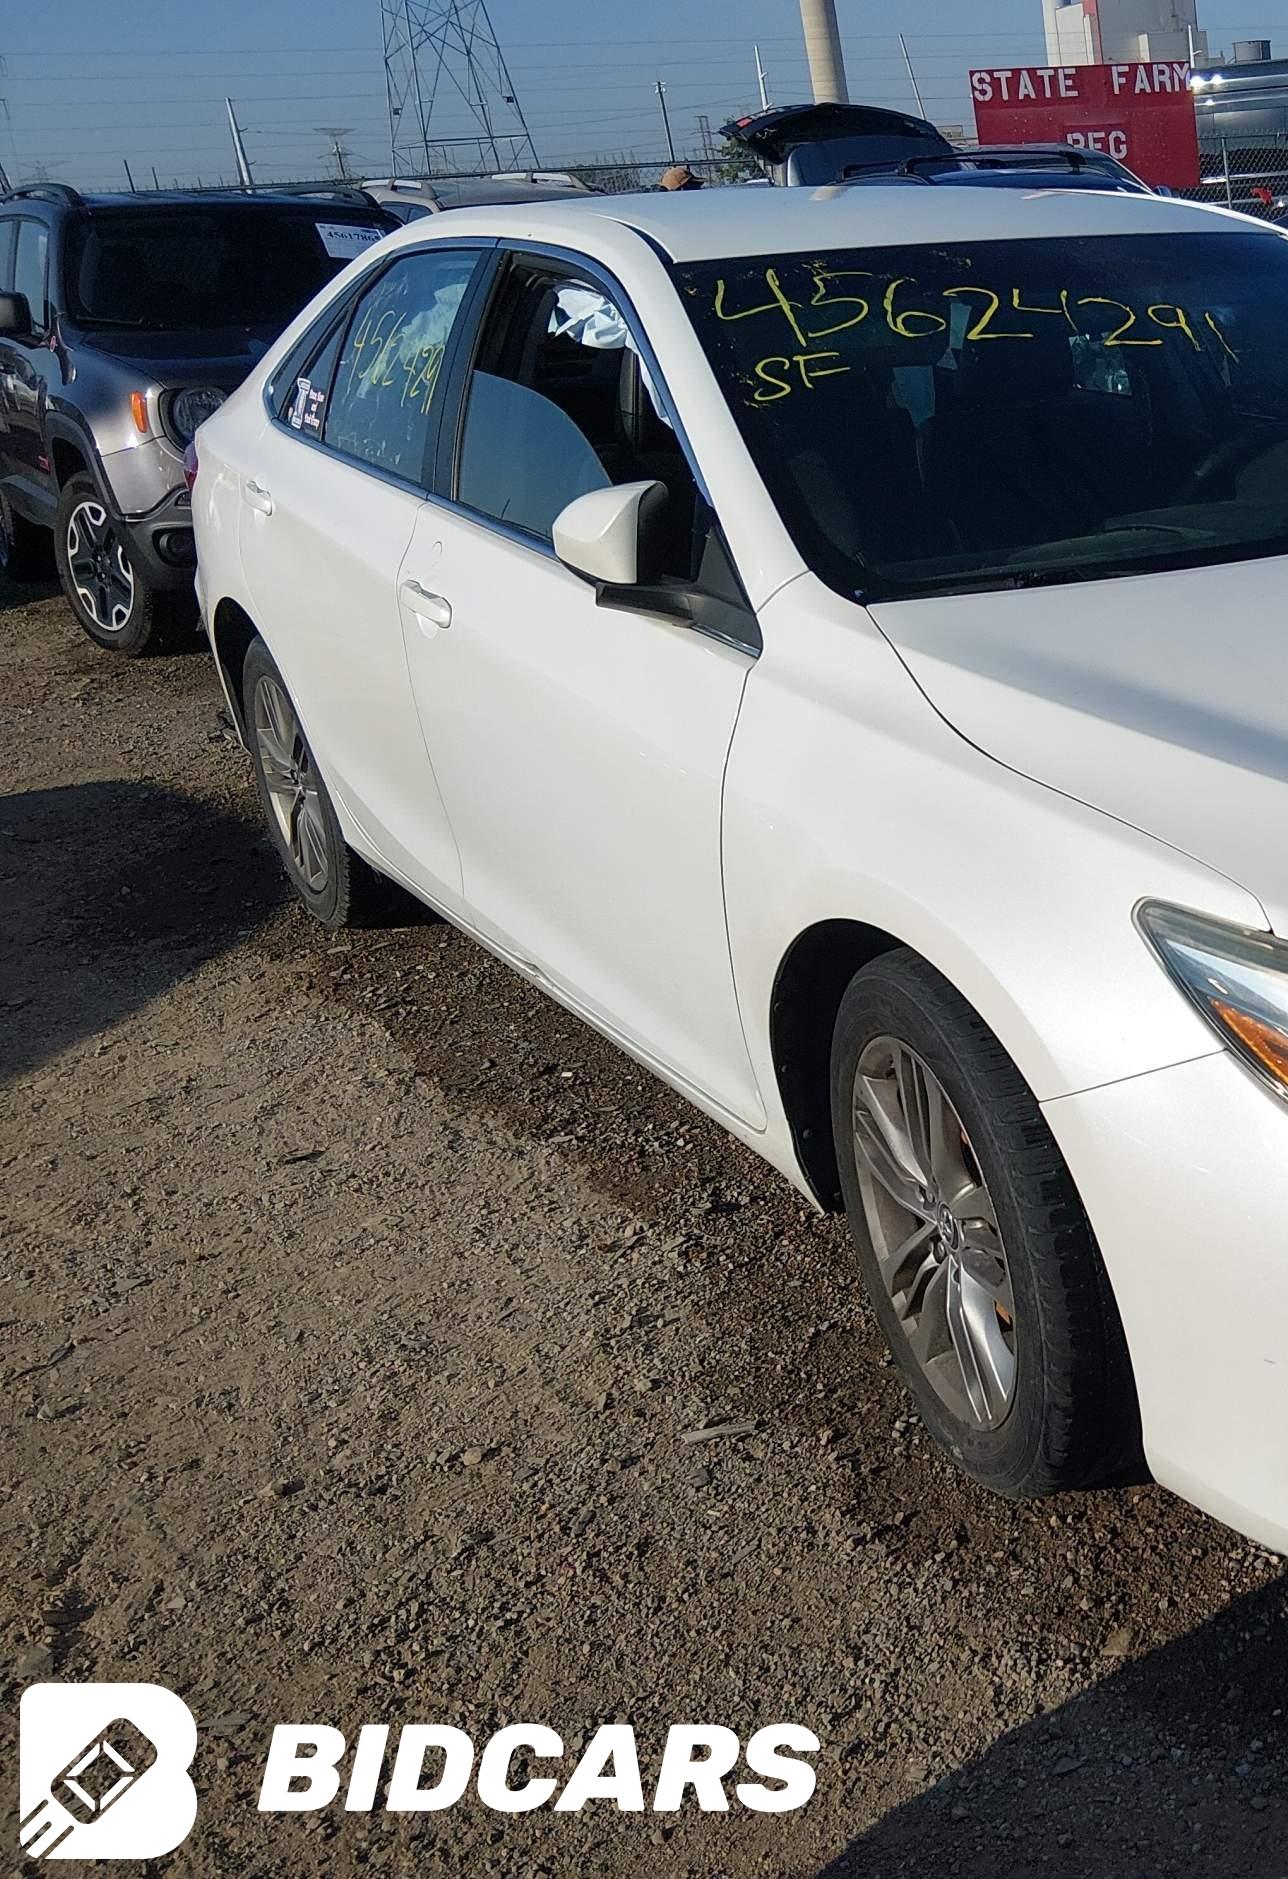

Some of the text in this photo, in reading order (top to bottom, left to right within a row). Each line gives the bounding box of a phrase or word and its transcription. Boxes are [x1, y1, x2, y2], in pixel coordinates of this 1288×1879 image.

[971, 62, 1192, 102] STATE FARM
[714, 268, 1240, 365] 45624291
[754, 351, 852, 402] SF
